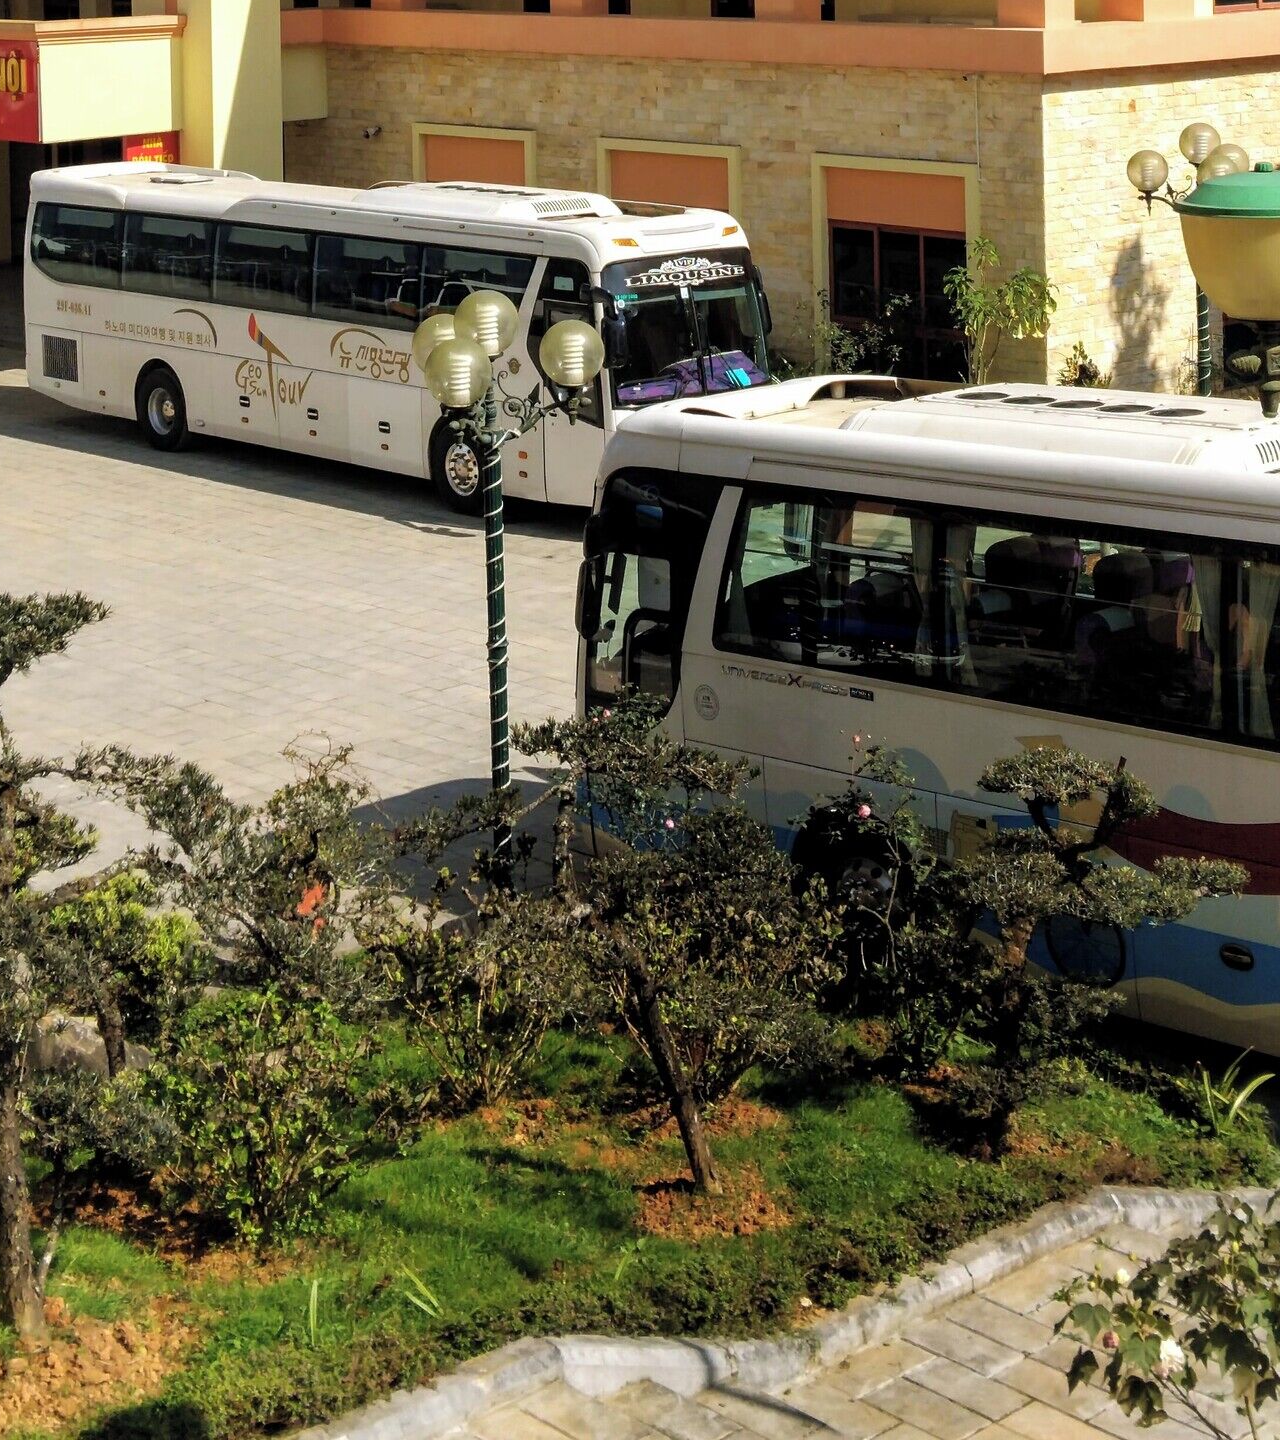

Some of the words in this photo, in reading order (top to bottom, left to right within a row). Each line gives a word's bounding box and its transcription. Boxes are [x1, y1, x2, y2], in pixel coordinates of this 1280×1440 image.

[143, 137, 163, 148] NHÀ
[624, 266, 745, 287] LIMOUSINE
[339, 342, 352, 368] 뉴
